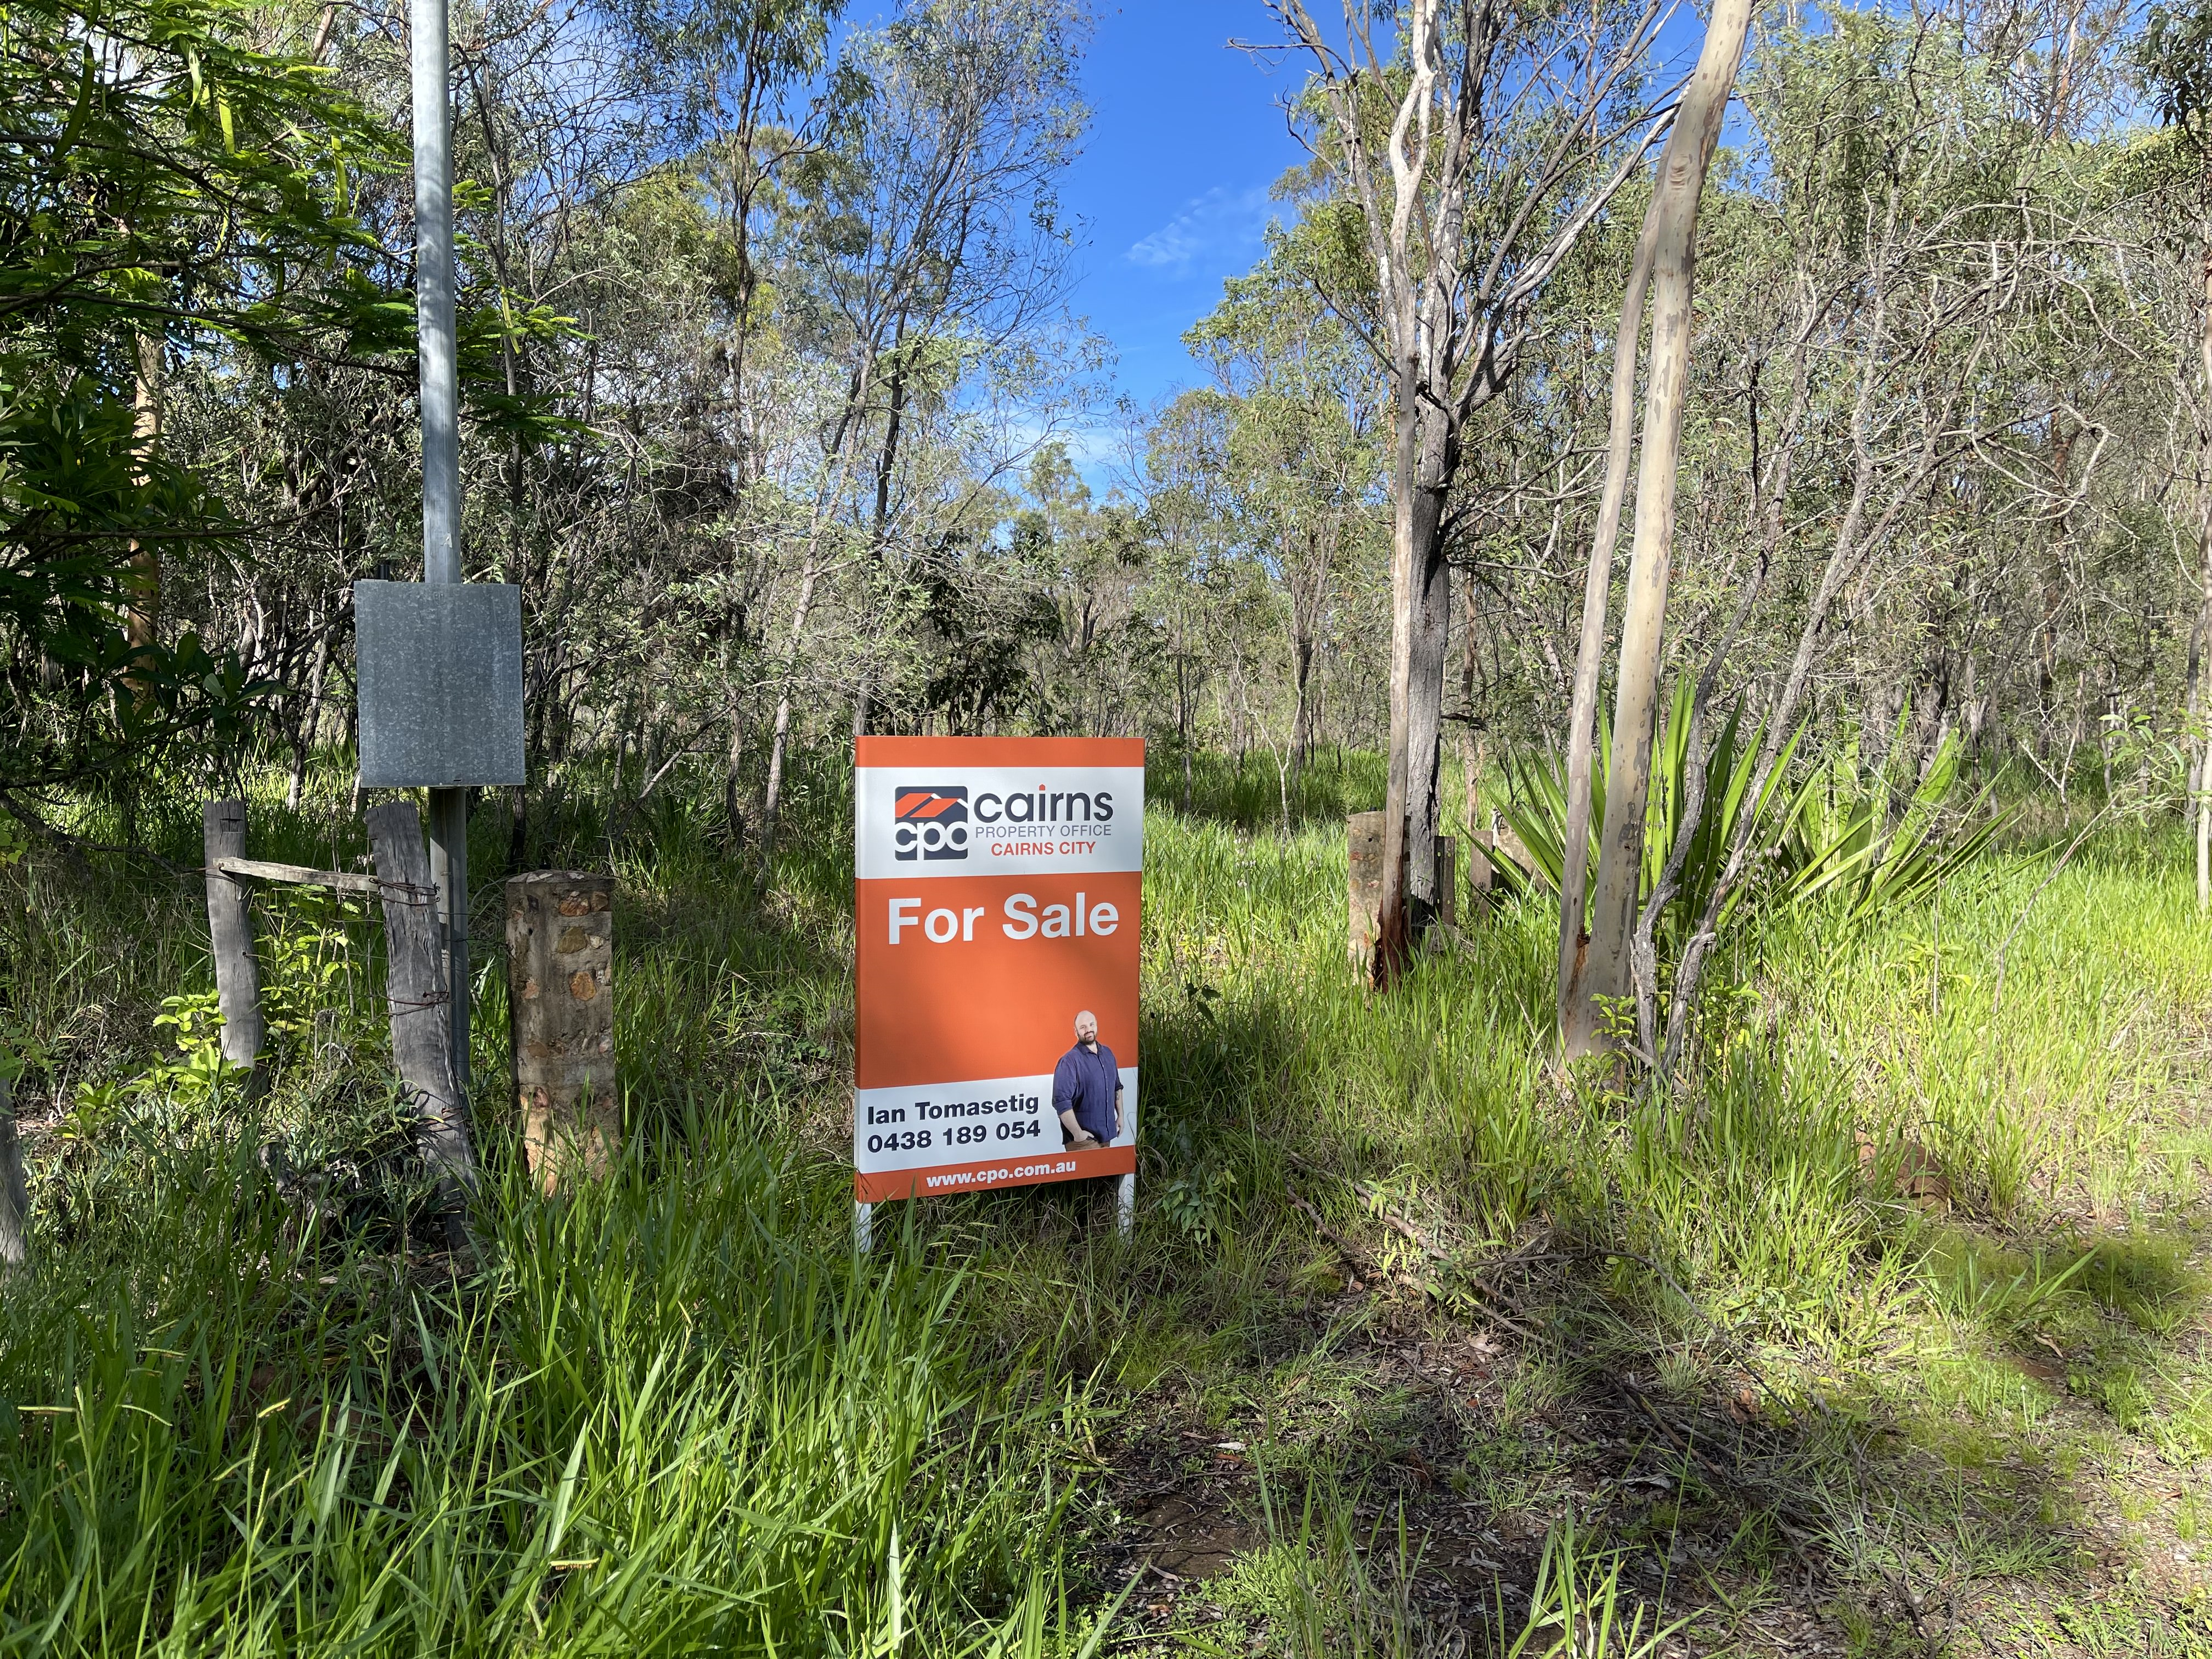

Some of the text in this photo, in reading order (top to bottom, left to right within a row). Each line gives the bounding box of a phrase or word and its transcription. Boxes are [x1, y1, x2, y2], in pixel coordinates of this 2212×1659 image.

[973, 784, 1113, 823] cairns
[975, 825, 1111, 838] PROPERTY OFFICE
[991, 841, 1096, 856] CAIRNS CITY
[889, 892, 1119, 945] For Sale
[867, 1093, 1039, 1125] Ian Tomasetig
[867, 1120, 1041, 1153] 0438 189 054
[926, 1160, 1076, 1188] www.cpo.com.au
